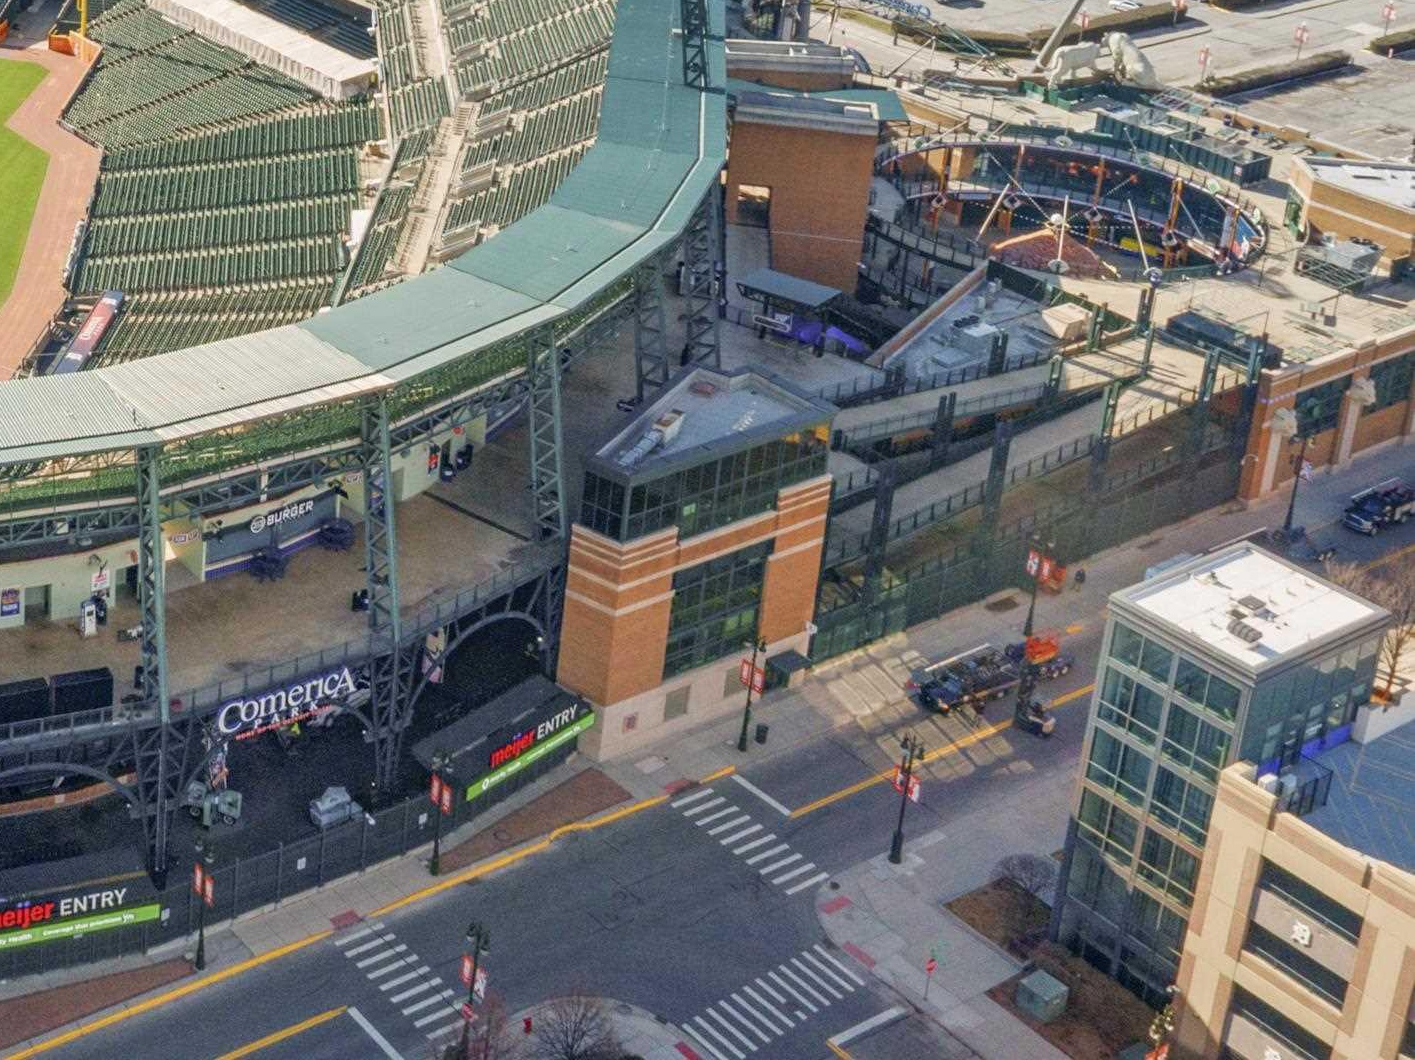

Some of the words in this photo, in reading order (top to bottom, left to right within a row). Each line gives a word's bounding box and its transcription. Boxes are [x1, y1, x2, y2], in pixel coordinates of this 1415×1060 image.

[266, 500, 314, 527] BURGER
[218, 667, 357, 734] ComericA
[254, 700, 319, 729] PARK
[489, 730, 537, 769] meijer
[537, 704, 578, 740] ENTRY
[59, 888, 127, 917] ENTRY
